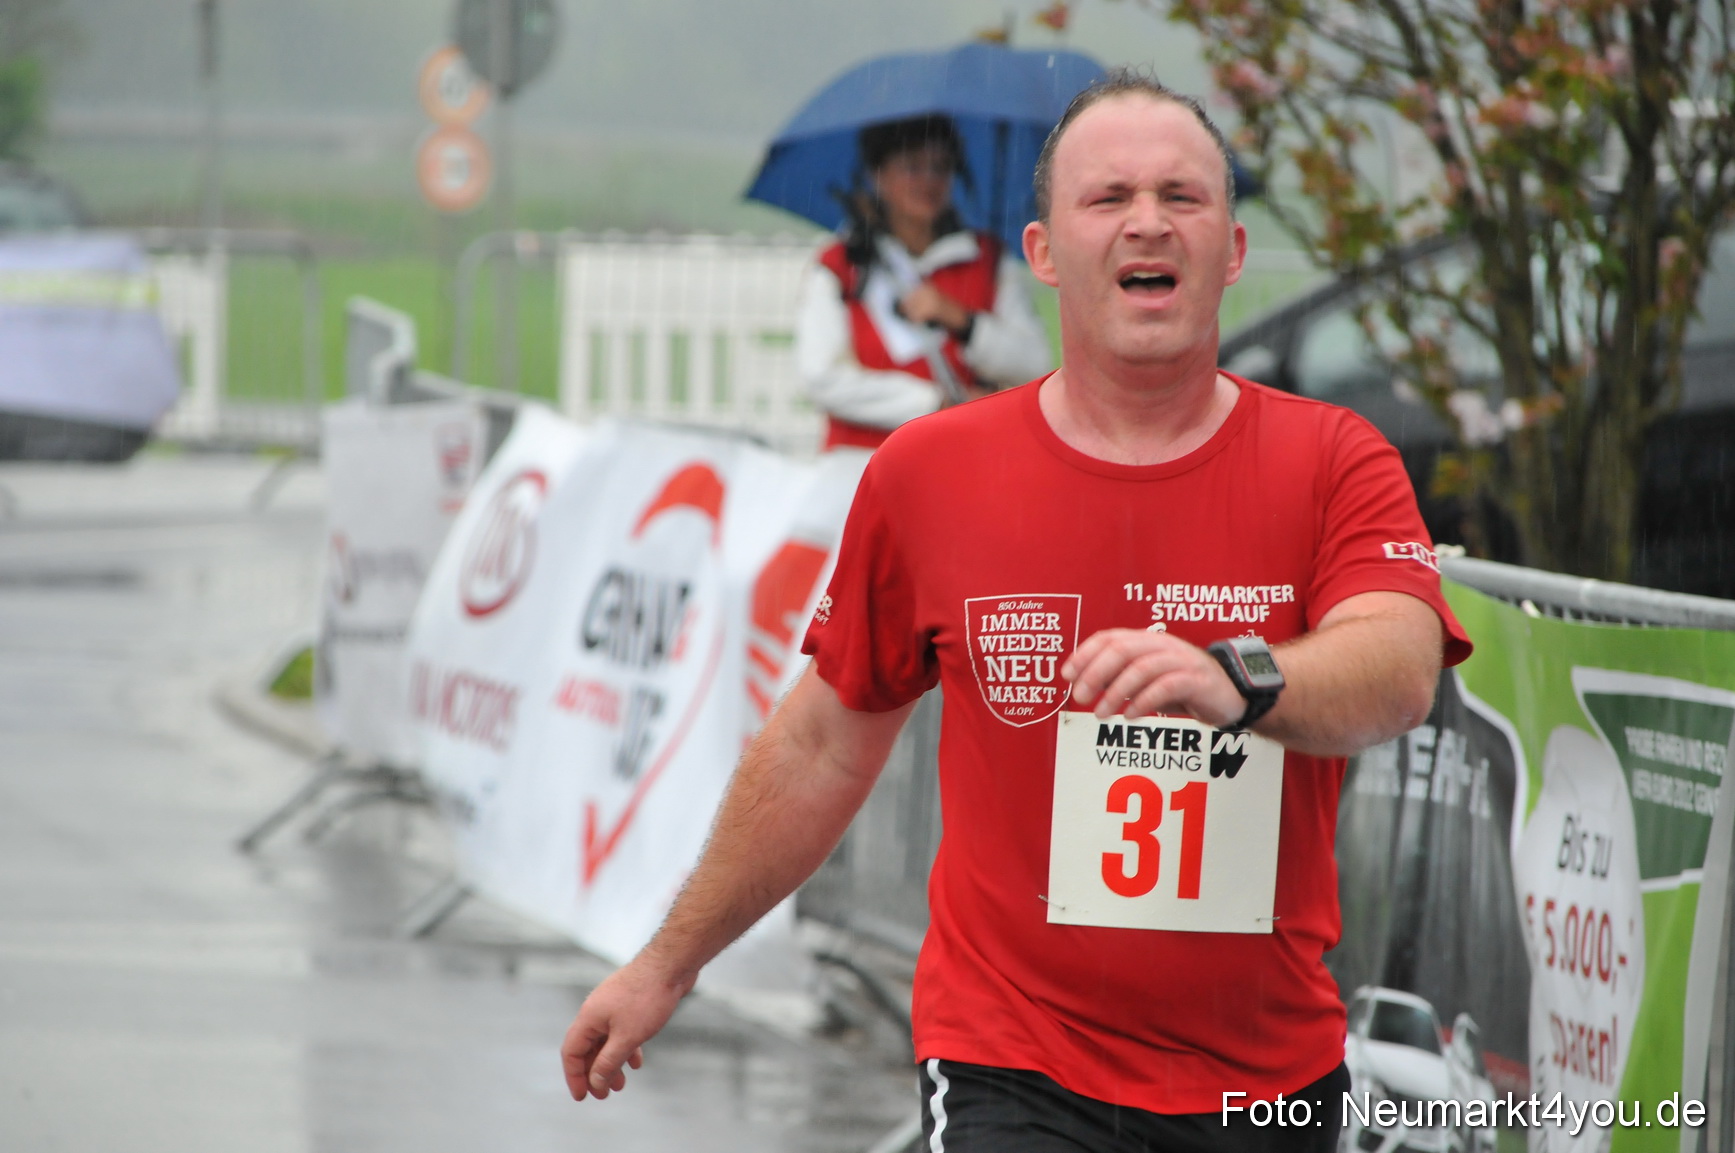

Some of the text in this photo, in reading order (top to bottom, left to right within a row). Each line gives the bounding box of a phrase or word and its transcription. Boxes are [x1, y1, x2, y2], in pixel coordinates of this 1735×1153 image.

[1123, 583, 1295, 604] 11. NEUMARKTER
[998, 600, 1044, 611] 850 Jahre
[1151, 602, 1270, 623] STADTLAUF
[981, 612, 1061, 633] IMMER
[978, 634, 1064, 653] WIEDER
[984, 655, 1058, 683] NEU
[988, 685, 1057, 704] MARKT
[1096, 723, 1203, 752] MEYER
[1096, 749, 1203, 772] WERBUNG
[1101, 774, 1208, 900] 31
[1557, 812, 1613, 880] Bis zu
